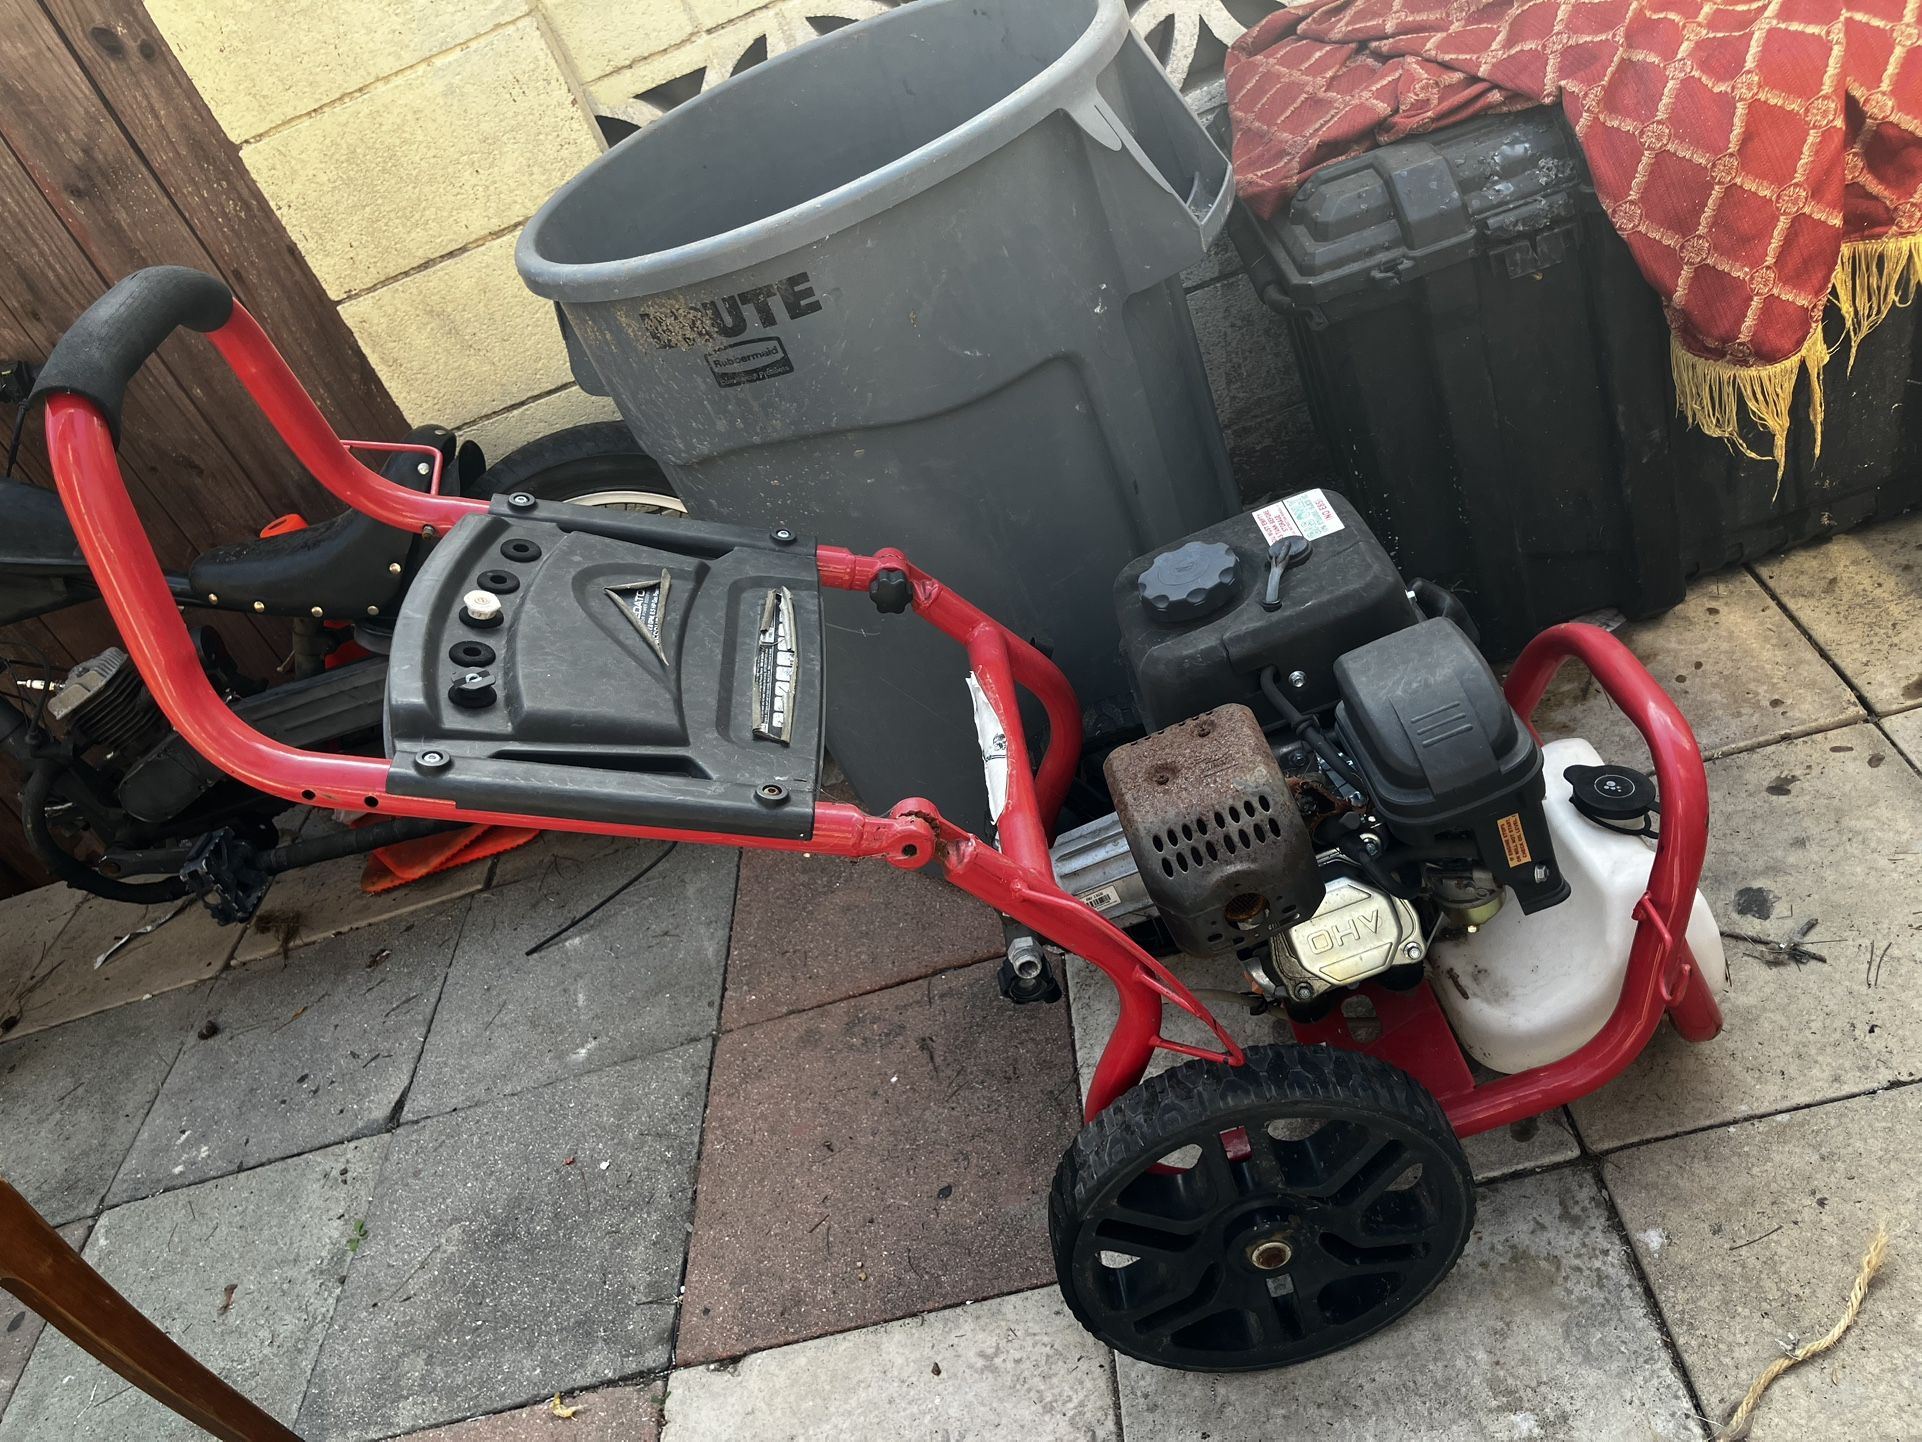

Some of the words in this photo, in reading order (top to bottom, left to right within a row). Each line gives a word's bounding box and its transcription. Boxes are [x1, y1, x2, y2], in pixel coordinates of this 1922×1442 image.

[639, 272, 822, 350] UTE
[713, 345, 779, 368] Rubbermaid
[1306, 908, 1379, 955] OHV
